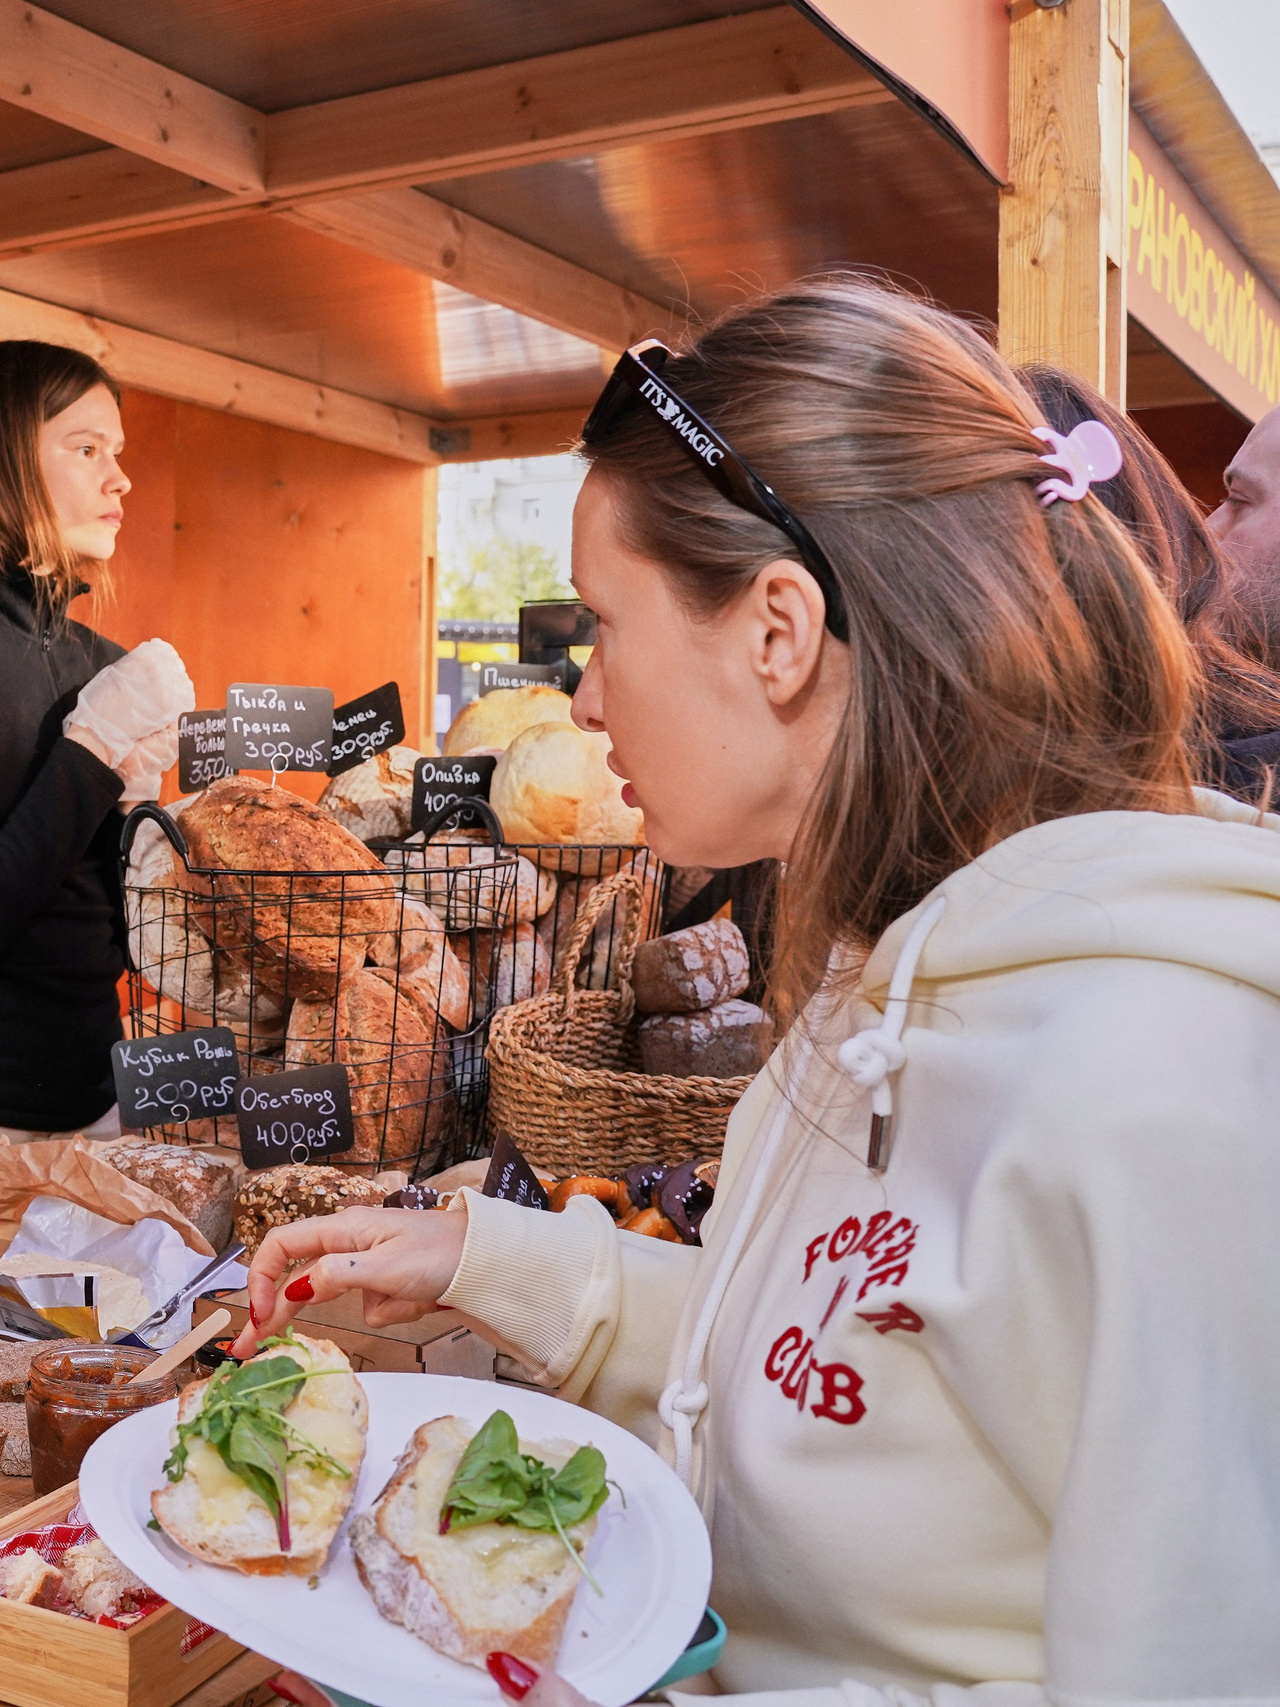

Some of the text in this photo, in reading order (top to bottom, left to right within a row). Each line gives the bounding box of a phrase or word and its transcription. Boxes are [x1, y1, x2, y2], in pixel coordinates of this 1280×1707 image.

[670, 413, 725, 467] MAGIC
[230, 688, 306, 711] Тыква и
[231, 717, 290, 737] Гречка
[119, 1045, 190, 1076] Кубик
